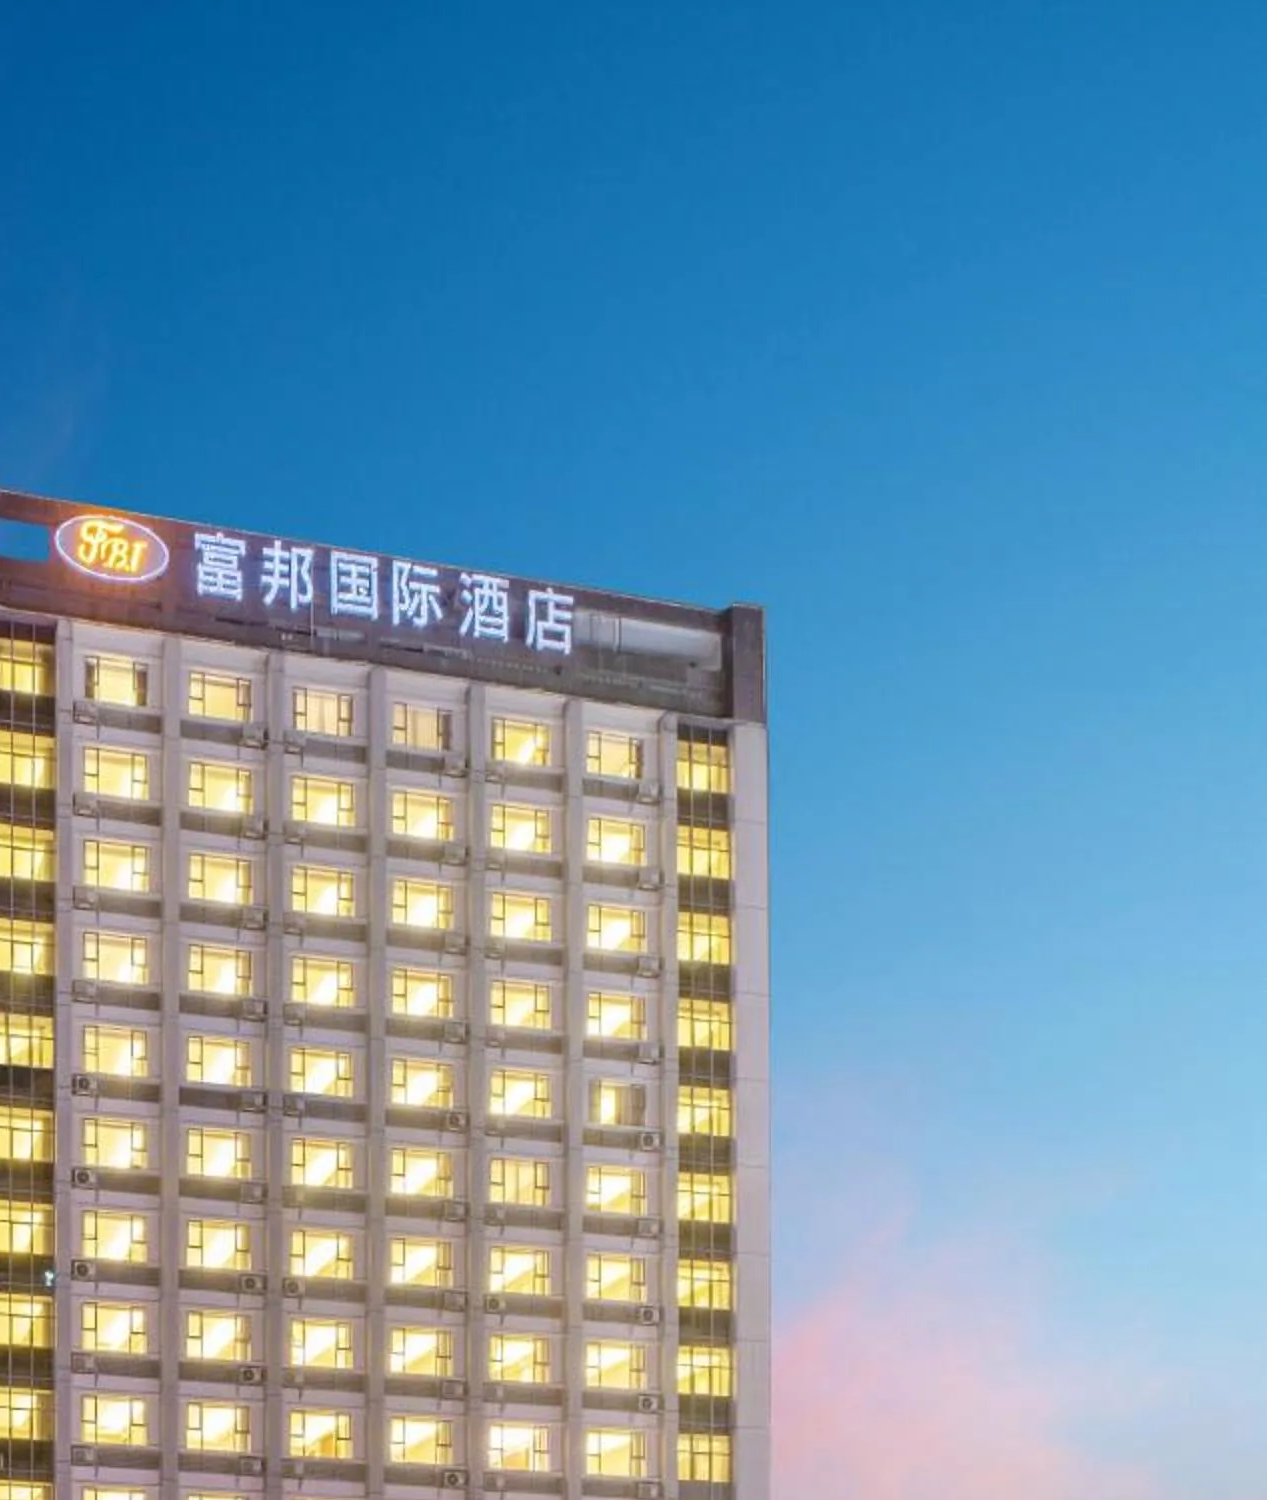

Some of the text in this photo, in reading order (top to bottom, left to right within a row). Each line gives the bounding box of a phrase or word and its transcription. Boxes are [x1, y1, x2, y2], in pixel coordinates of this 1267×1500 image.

[194, 531, 574, 655] 富邦国际酒店
